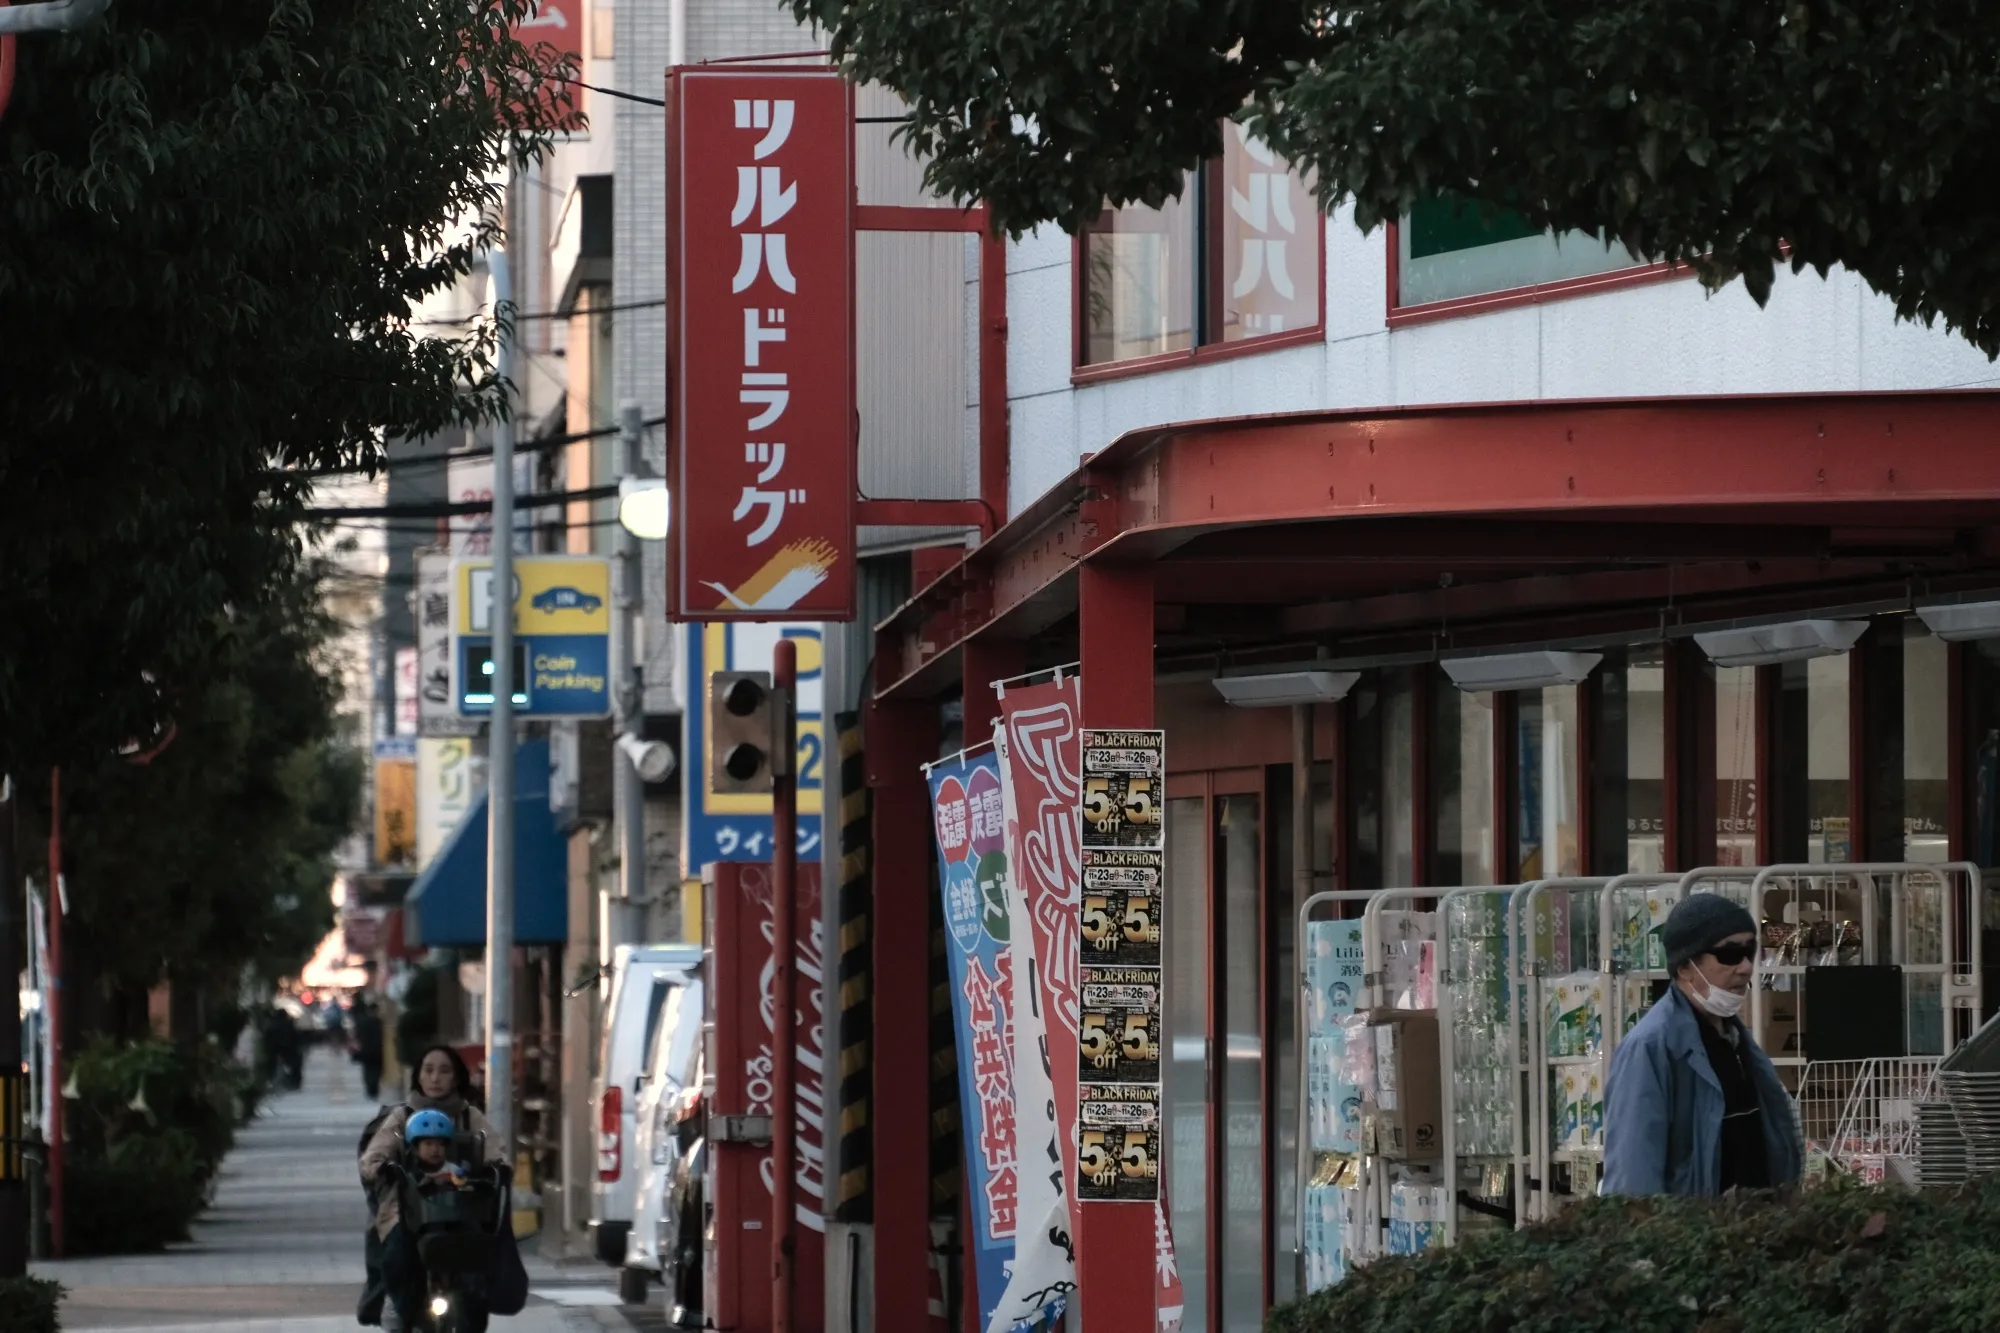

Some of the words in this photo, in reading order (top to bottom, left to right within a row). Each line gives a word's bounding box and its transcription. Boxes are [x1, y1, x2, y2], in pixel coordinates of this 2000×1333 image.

[731, 98, 806, 548] ツルハドラッグ
[534, 653, 577, 671] Coin
[535, 673, 605, 692] Parking
[1095, 735, 1127, 747] BLACK
[1128, 736, 1161, 748] FRIDAY
[1098, 814, 1121, 833] off
[715, 826, 821, 855] ウィン
[1093, 853, 1126, 865] BLACK
[1127, 854, 1160, 866] FRIDAY
[1095, 932, 1119, 952] off
[1092, 971, 1125, 982] BLACK
[1126, 972, 1159, 983] FRIDAY
[1094, 1049, 1118, 1069] off
[1091, 1088, 1123, 1100] BLACK
[1124, 1088, 1158, 1101] FRIDAY
[1094, 1166, 1117, 1186] off
